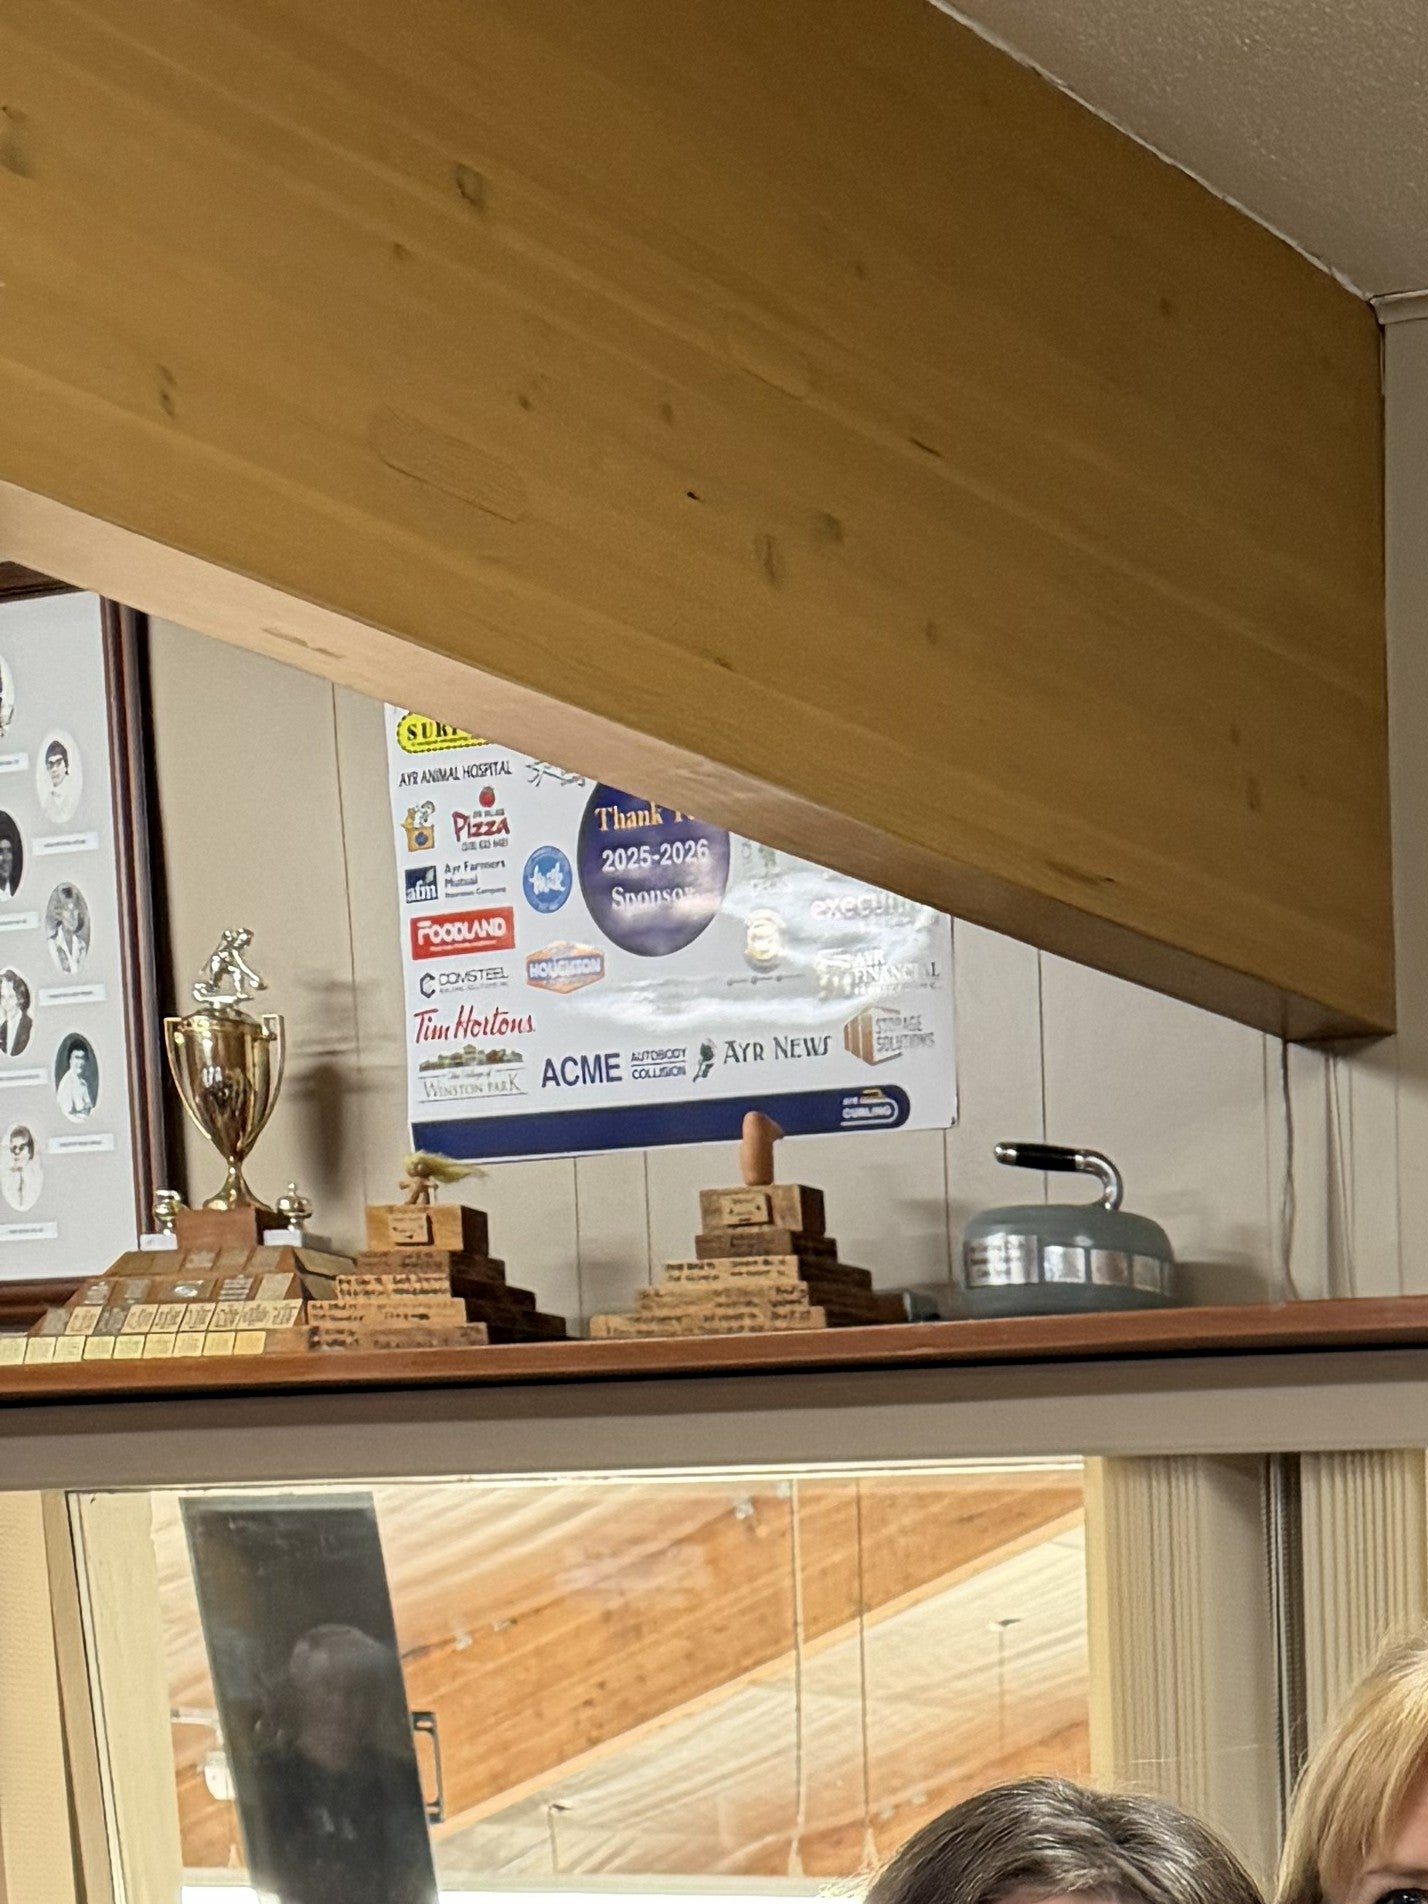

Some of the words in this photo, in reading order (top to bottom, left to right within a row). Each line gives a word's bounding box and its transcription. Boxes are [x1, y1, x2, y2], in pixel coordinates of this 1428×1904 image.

[399, 771, 418, 787] AYR
[421, 766, 461, 784] ANIMAL
[463, 761, 512, 779] HOSPITAL
[594, 801, 663, 832] Thank
[444, 863, 461, 875] Ayr
[464, 859, 506, 871] Farmers
[601, 838, 710, 873] 2025-2026
[406, 880, 437, 902] afm
[416, 917, 507, 946] FOODLAND
[529, 957, 601, 979] HOUGHTON
[413, 1008, 450, 1044] Tim
[454, 1004, 534, 1039] Hortons
[631, 1048, 687, 1062] AUTOBODY
[723, 1040, 764, 1065] AYR
[773, 1035, 832, 1060] NEWS
[541, 1053, 623, 1088] ACME
[631, 1065, 687, 1080] COLLISION
[423, 1081, 483, 1098] WINSTON
